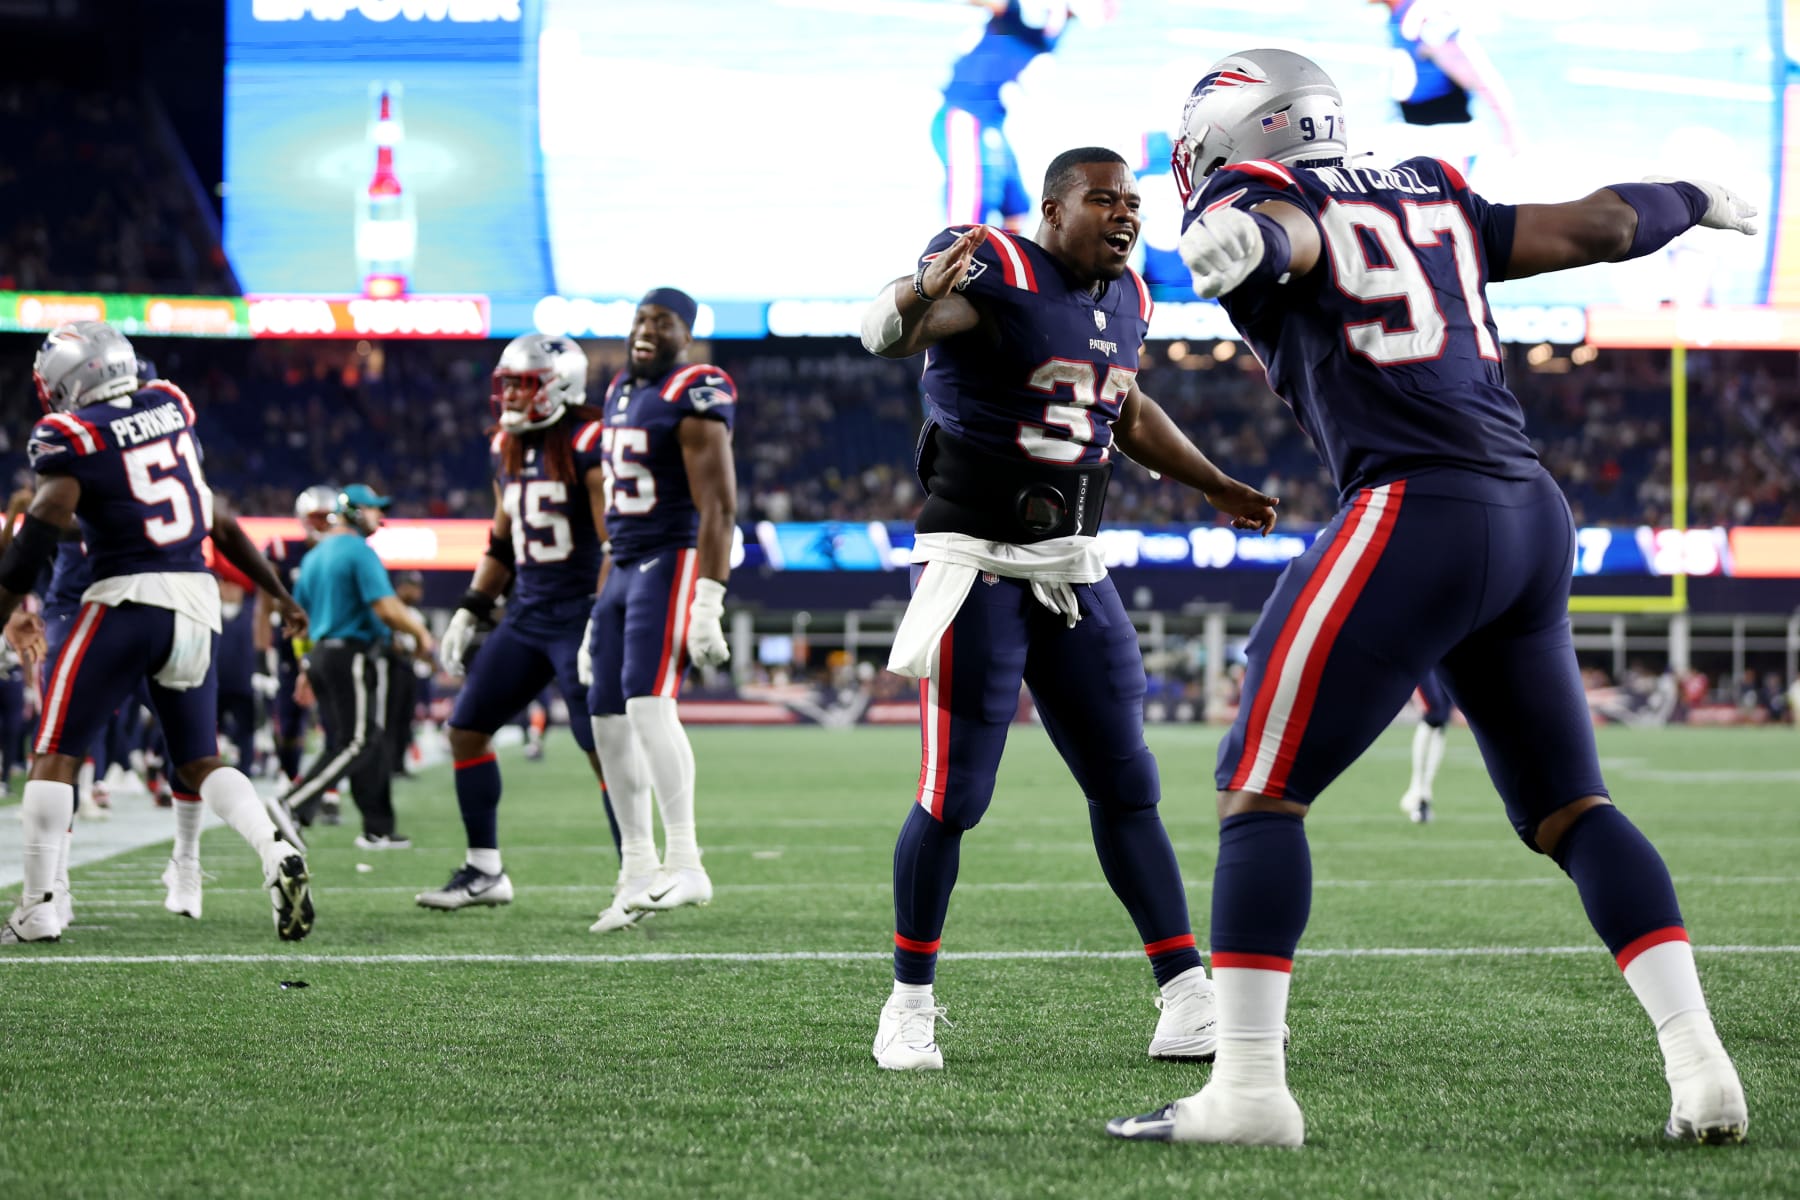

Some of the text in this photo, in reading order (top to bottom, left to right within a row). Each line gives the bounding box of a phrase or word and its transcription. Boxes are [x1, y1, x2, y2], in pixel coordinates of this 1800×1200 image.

[1300, 116, 1334, 141] 97
[1304, 166, 1440, 194] MITCHELL
[1319, 196, 1499, 365] 97
[1089, 338, 1118, 357] PATRIOTS
[110, 402, 185, 447] PERKINS
[1016, 356, 1138, 465] 37
[121, 431, 214, 547] 51
[502, 480, 574, 564] 15
